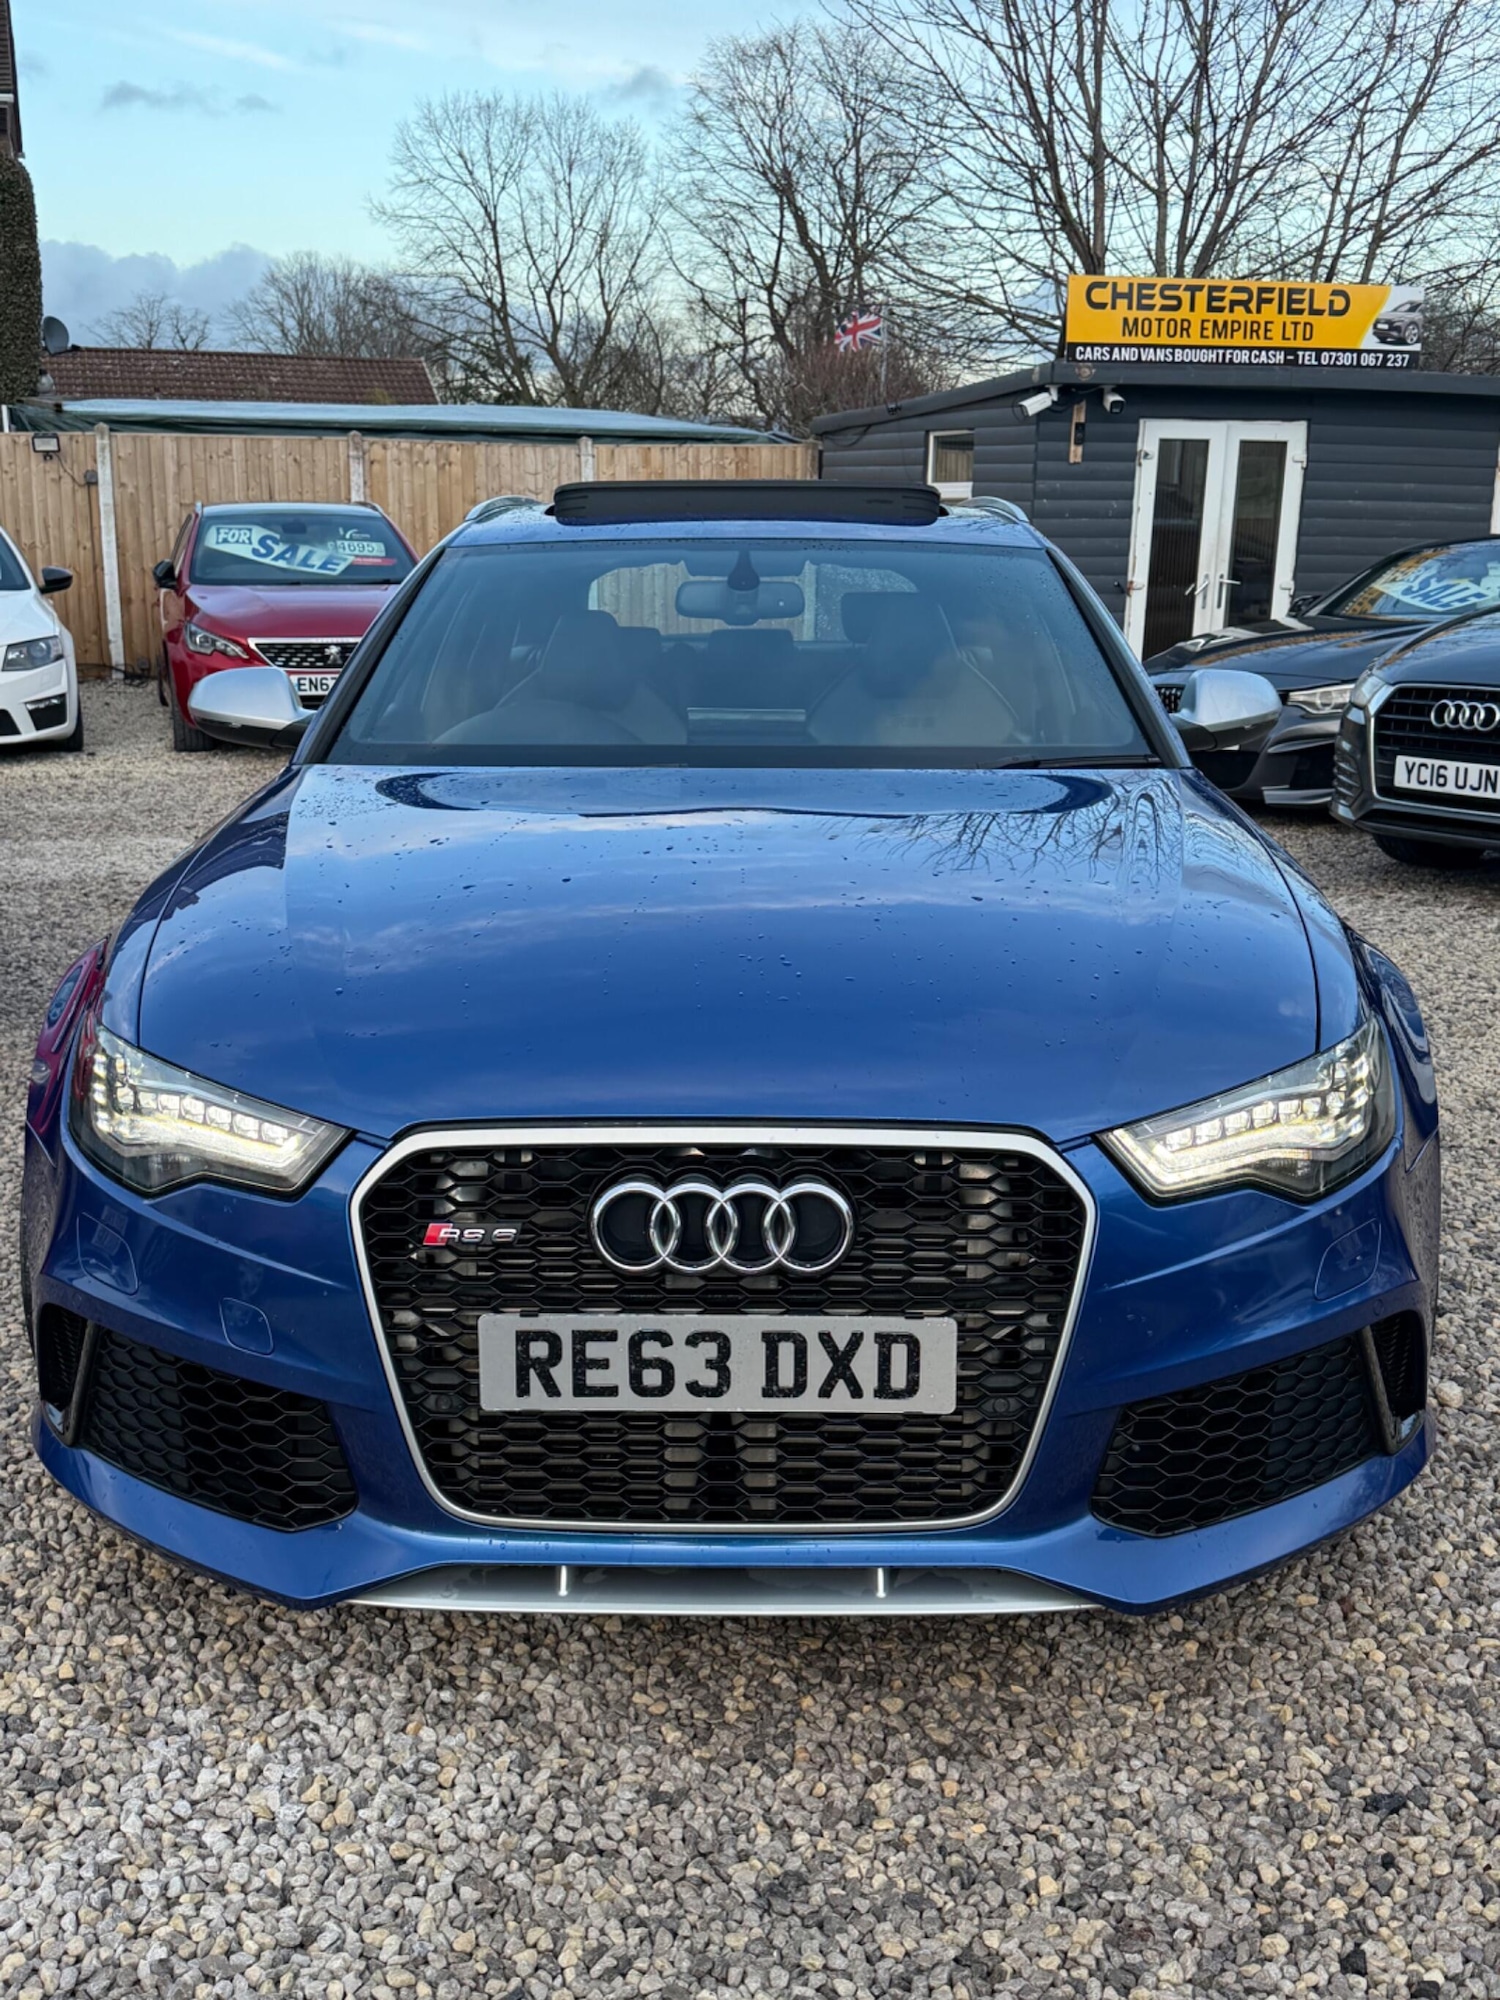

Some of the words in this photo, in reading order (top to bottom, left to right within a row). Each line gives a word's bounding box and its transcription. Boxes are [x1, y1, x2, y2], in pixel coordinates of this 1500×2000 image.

[1085, 281, 1350, 316] CHESTERFIELD
[1121, 317, 1191, 339] MOTOR
[1200, 319, 1273, 341] EMPIRE
[1281, 322, 1314, 342] LTD
[1075, 346, 1110, 361] CARS
[1111, 347, 1139, 361] AND
[1140, 348, 1173, 362] VANS
[1174, 349, 1224, 363] BOUGHT
[1225, 350, 1249, 363] FOR
[1251, 350, 1284, 364] CASH
[1297, 351, 1318, 365] TEL
[1321, 352, 1357, 366] 07301
[1360, 353, 1383, 366] 067
[1386, 353, 1410, 367] 237
[215, 527, 252, 545] FOR
[251, 534, 347, 572] SALE
[1401, 580, 1489, 608] SALE
[1404, 760, 1448, 788] YC16
[1454, 766, 1499, 794] UJN
[514, 1329, 732, 1398] RE63
[760, 1330, 922, 1400] DXD
